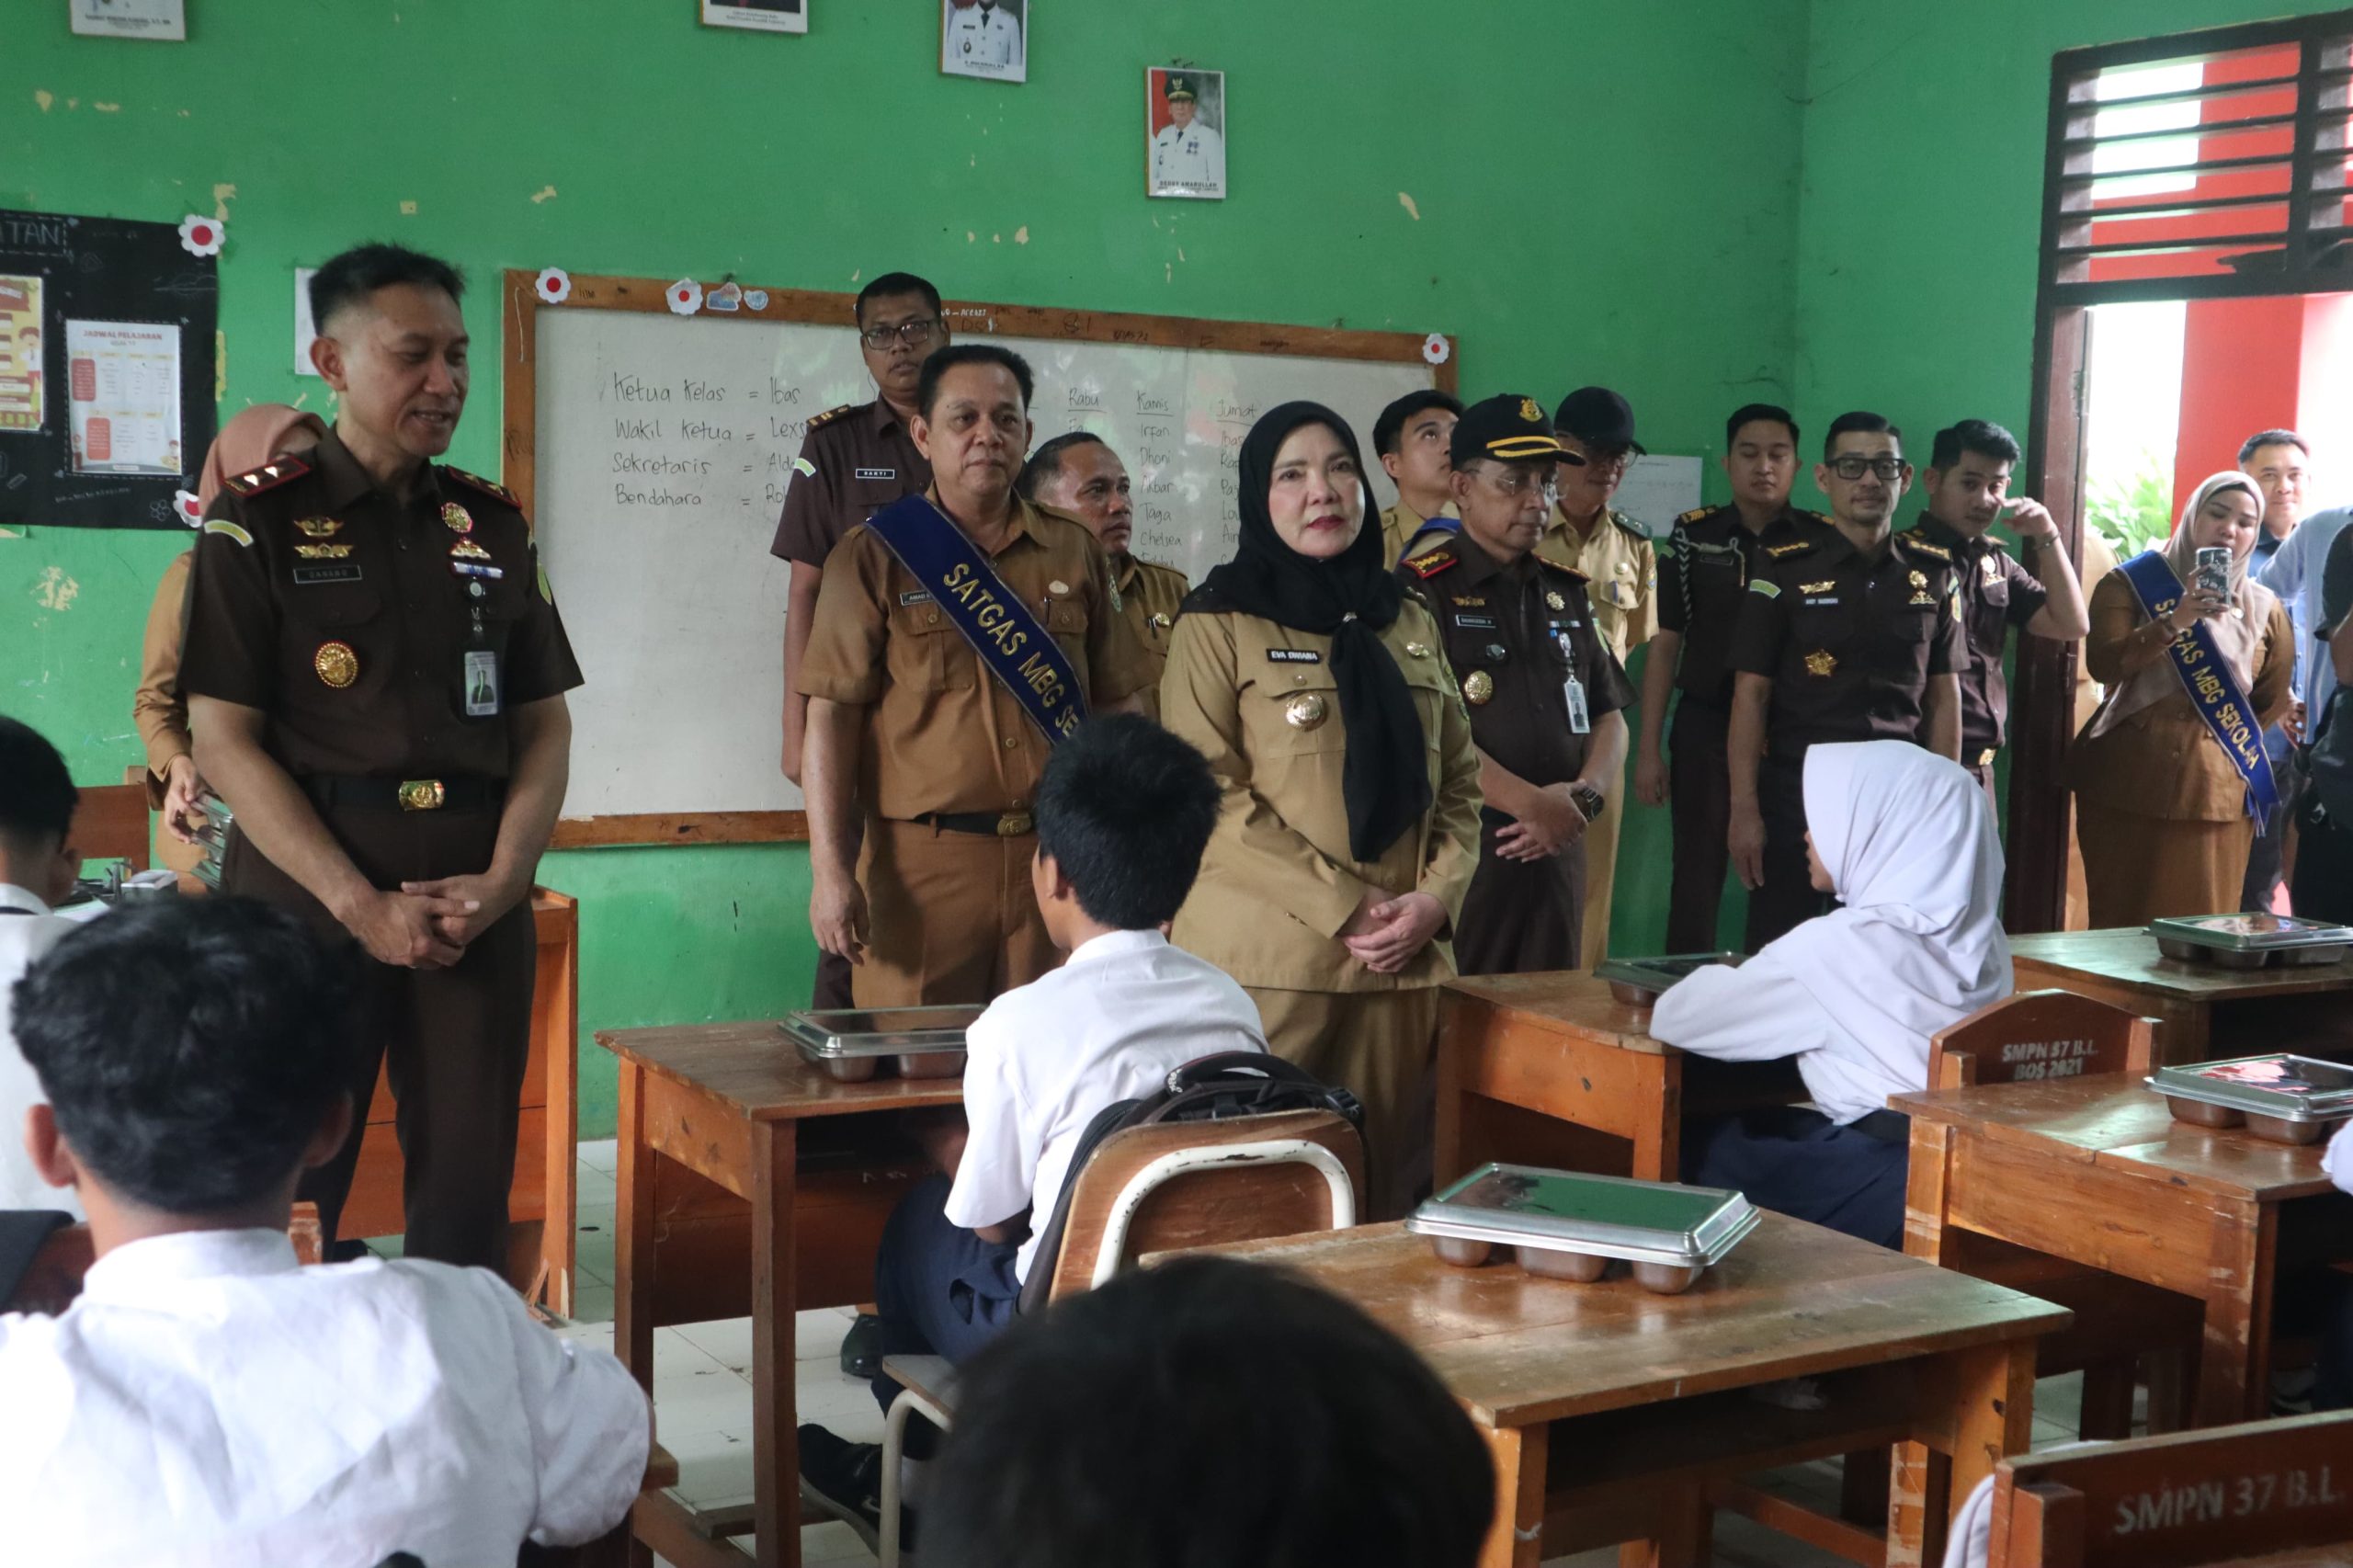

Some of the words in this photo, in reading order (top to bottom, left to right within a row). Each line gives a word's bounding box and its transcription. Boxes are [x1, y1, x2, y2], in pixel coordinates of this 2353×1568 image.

[0, 221, 59, 245] TAN
[614, 371, 671, 403] Ketua
[770, 376, 800, 404] Ibas
[1068, 388, 1099, 406] Rabu
[1136, 390, 1169, 412] Kamis
[1140, 424, 1170, 442] Irfan
[612, 451, 712, 475] Sekretaris
[1140, 447, 1171, 467] Dhoni
[615, 483, 701, 506] Bendahara
[1139, 502, 1172, 525] Taga
[1140, 529, 1182, 548] Chelsea
[943, 563, 1028, 656] SATGAS
[1017, 651, 1065, 708] MBG
[1271, 651, 1287, 659] EVA
[1288, 651, 1318, 661] DWIANA
[2191, 665, 2226, 704] MBG
[2215, 702, 2261, 770] SEKOLAH
[2002, 1042, 2048, 1062] SMPN
[2014, 1062, 2046, 1081] BOS
[2048, 1058, 2084, 1078] 2021
[2113, 1481, 2225, 1536] SMPN
[2234, 1473, 2278, 1517] 37
